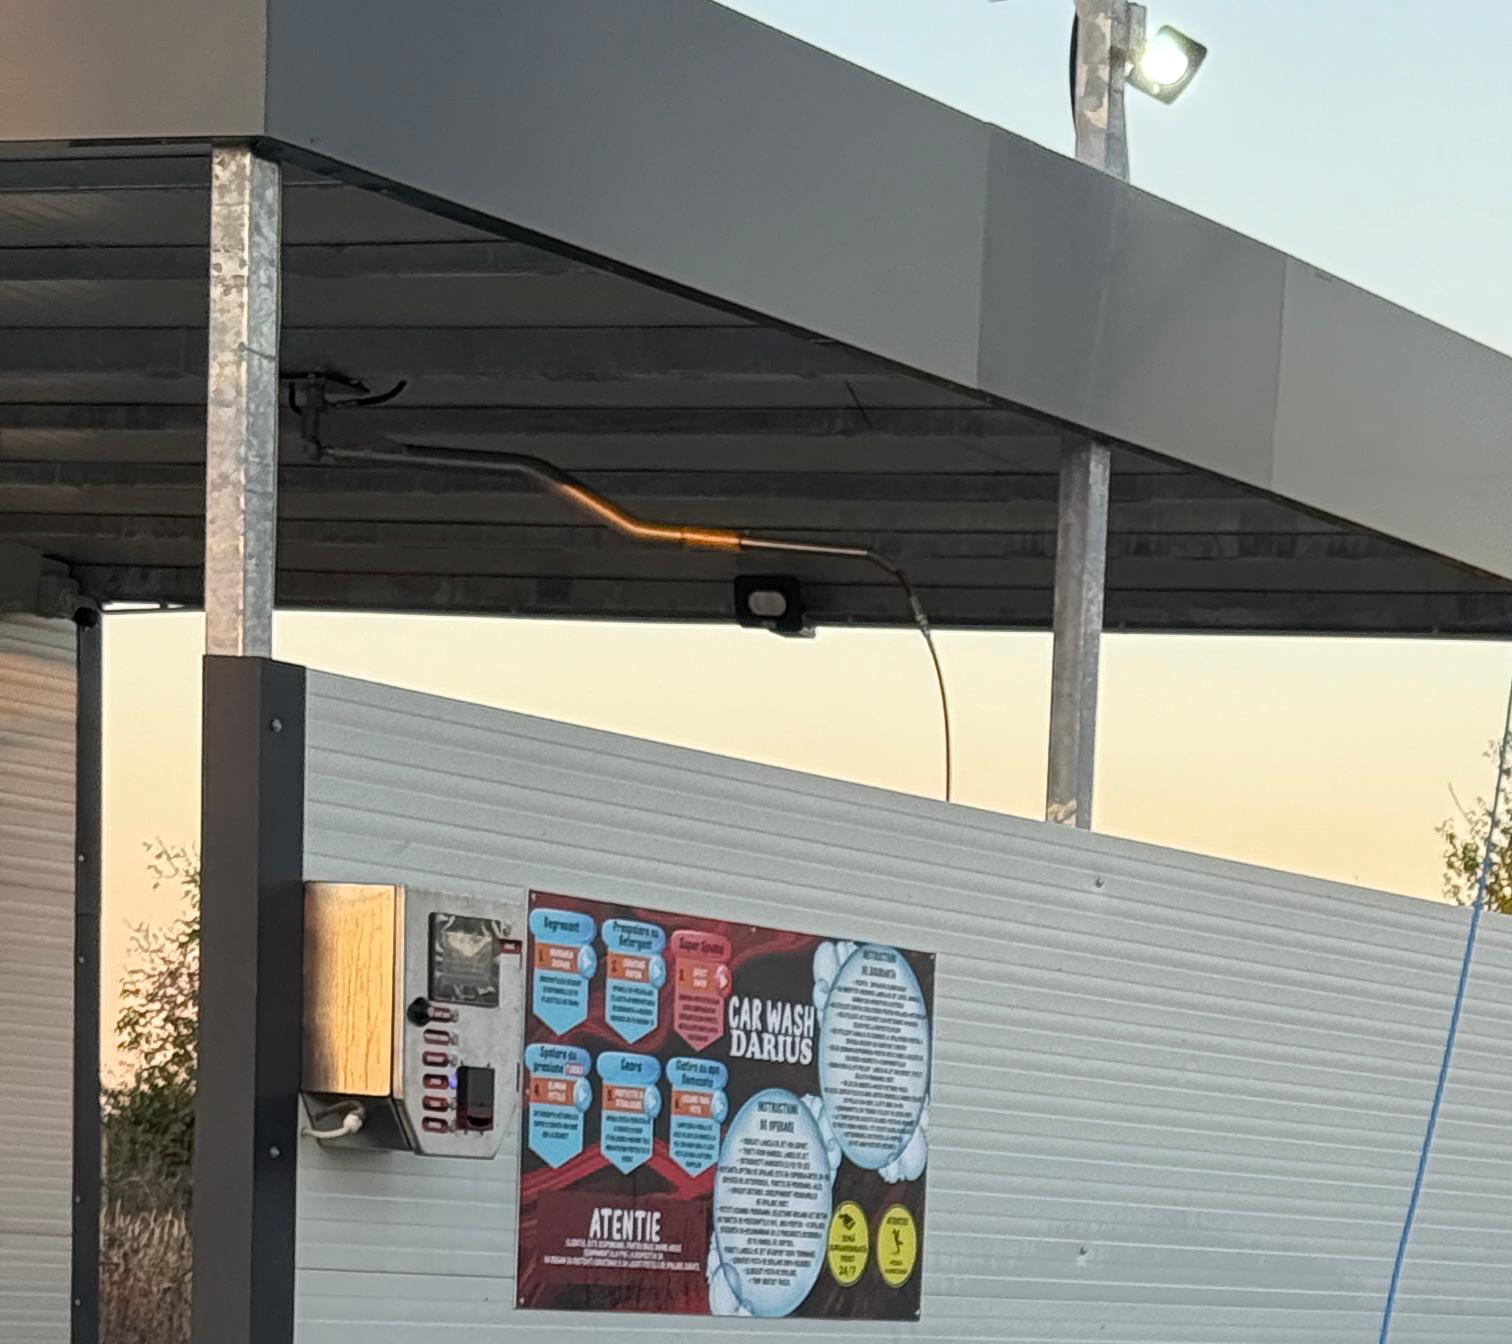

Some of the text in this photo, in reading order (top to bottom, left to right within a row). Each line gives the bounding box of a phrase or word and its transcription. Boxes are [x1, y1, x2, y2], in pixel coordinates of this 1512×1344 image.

[729, 995, 762, 1031] CAR
[766, 999, 815, 1038] WASH
[729, 1028, 813, 1066] DARIUS
[589, 1207, 662, 1243] ATENTIE
